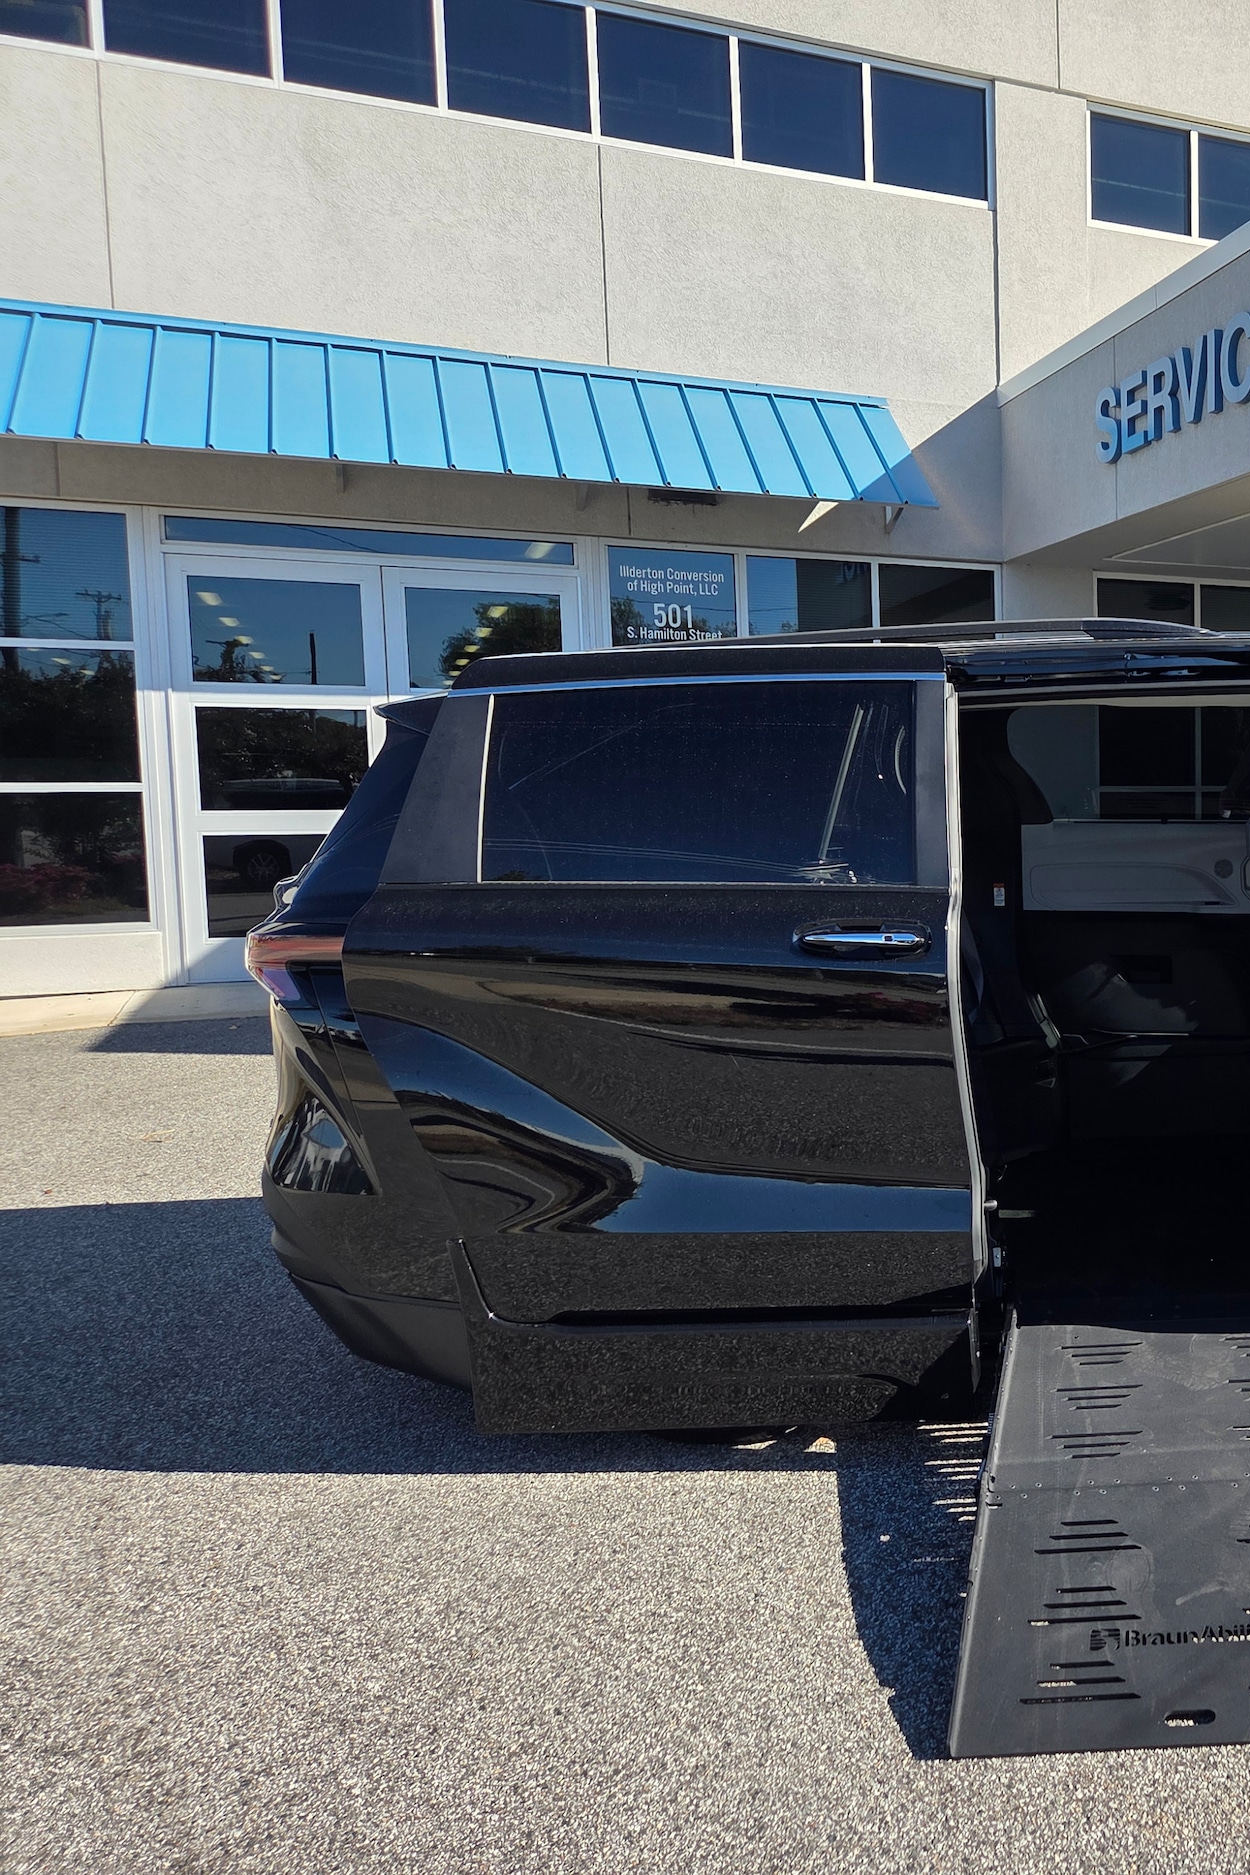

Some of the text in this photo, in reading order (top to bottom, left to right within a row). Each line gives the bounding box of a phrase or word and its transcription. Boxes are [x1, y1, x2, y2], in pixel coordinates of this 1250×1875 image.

[619, 565, 725, 583] Illderton Conversion
[627, 579, 719, 597] of High Point, LLC
[653, 603, 693, 628] 501
[626, 626, 722, 640] S. Hamilton Street
